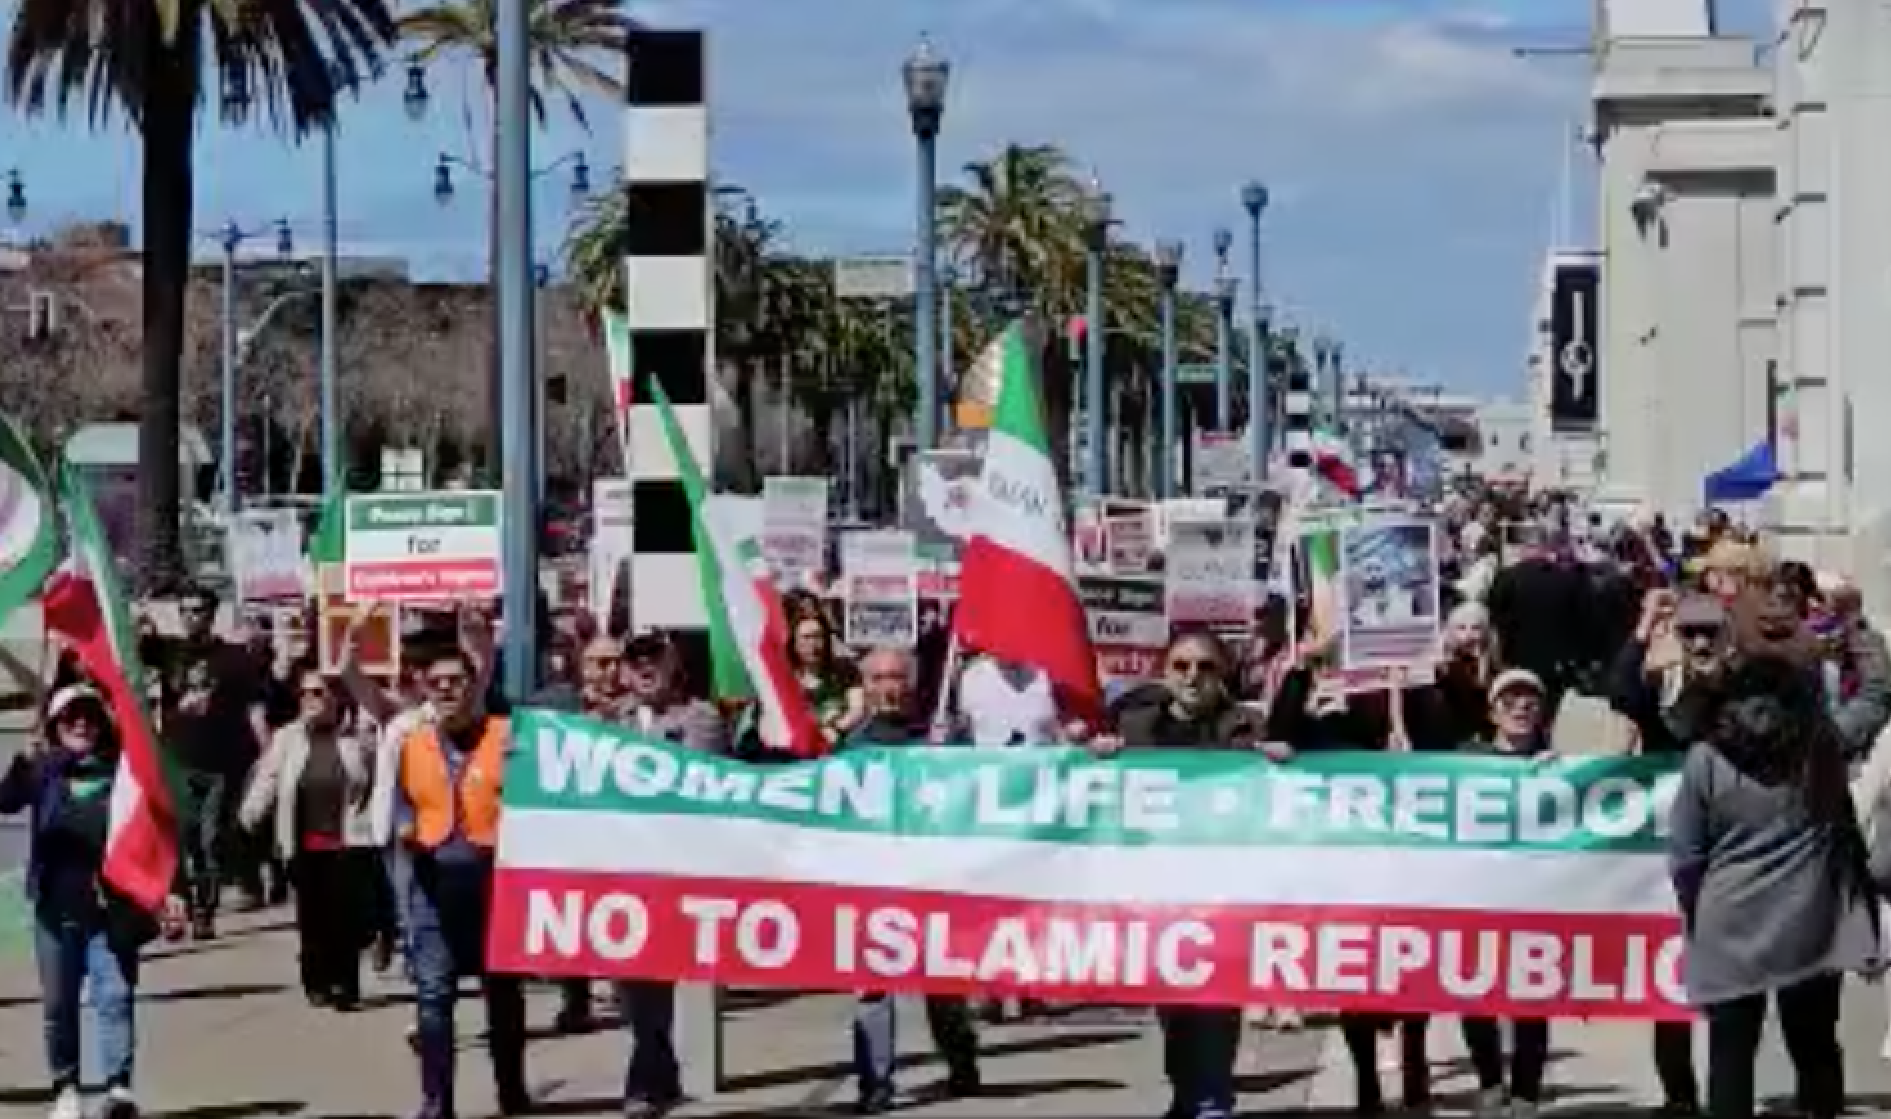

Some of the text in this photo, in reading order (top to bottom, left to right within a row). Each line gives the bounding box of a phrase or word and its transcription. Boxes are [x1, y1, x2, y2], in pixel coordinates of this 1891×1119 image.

[407, 533, 441, 555] for
[1095, 616, 1131, 636] for
[536, 726, 894, 820] WOMEN
[976, 763, 1181, 829] LIFE
[524, 888, 650, 962] NO
[679, 894, 801, 970] TO
[833, 905, 1217, 988] ISLAMIC
